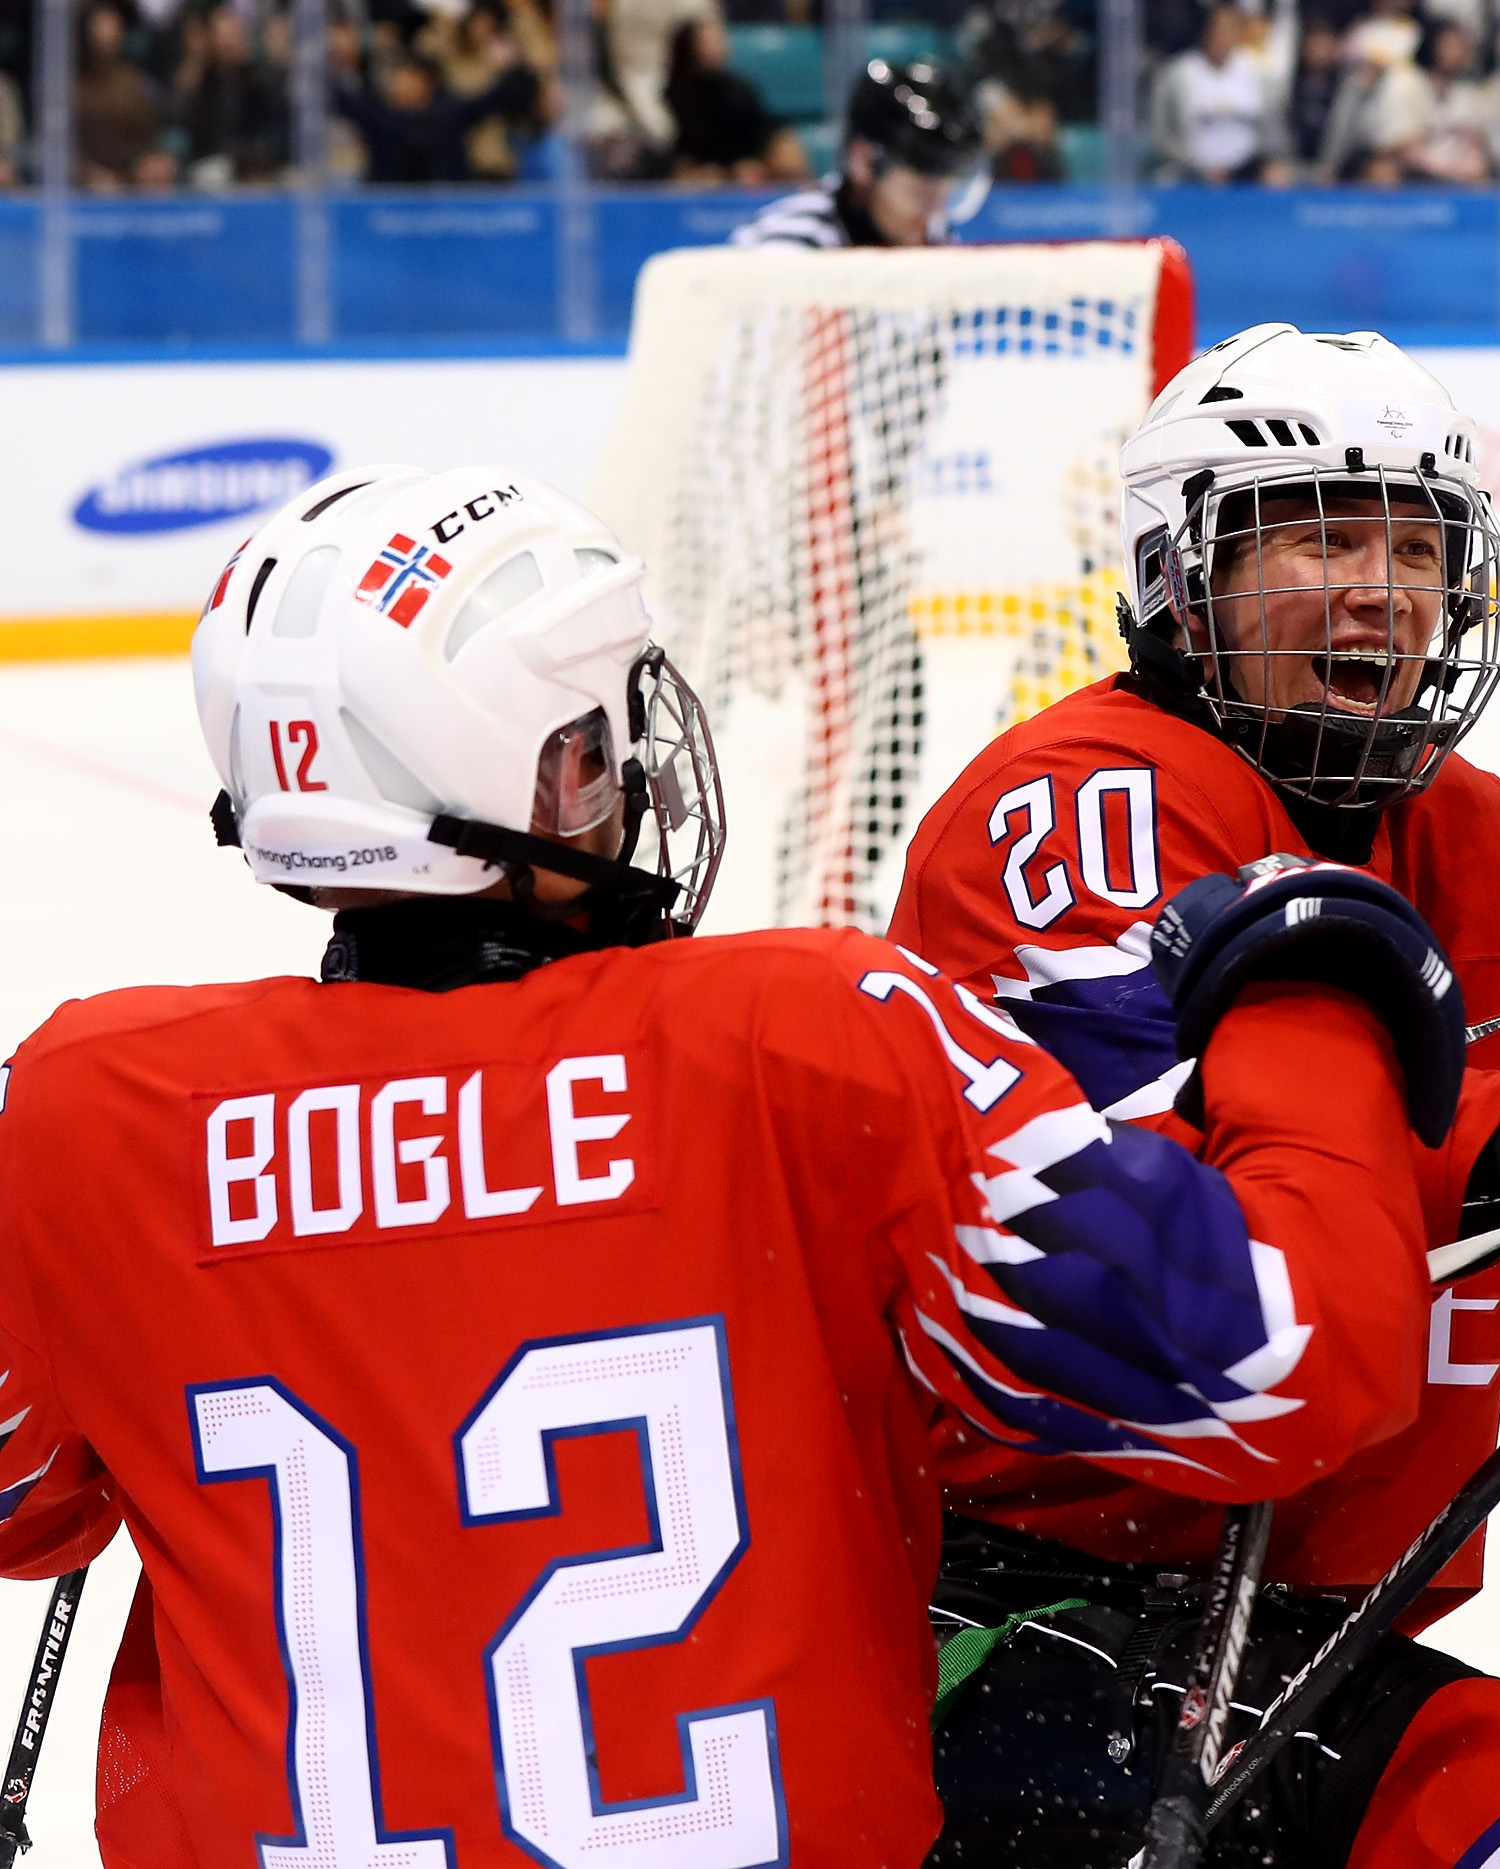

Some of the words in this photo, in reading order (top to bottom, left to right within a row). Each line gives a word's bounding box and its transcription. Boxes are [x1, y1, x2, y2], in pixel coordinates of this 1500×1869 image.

[269, 720, 328, 792] 12
[348, 845, 398, 866] 2018
[987, 766, 1163, 931] 20
[207, 1054, 635, 1247] BOGLE
[185, 1312, 790, 1869] 12
[1258, 1502, 1452, 1730] FRONTIER
